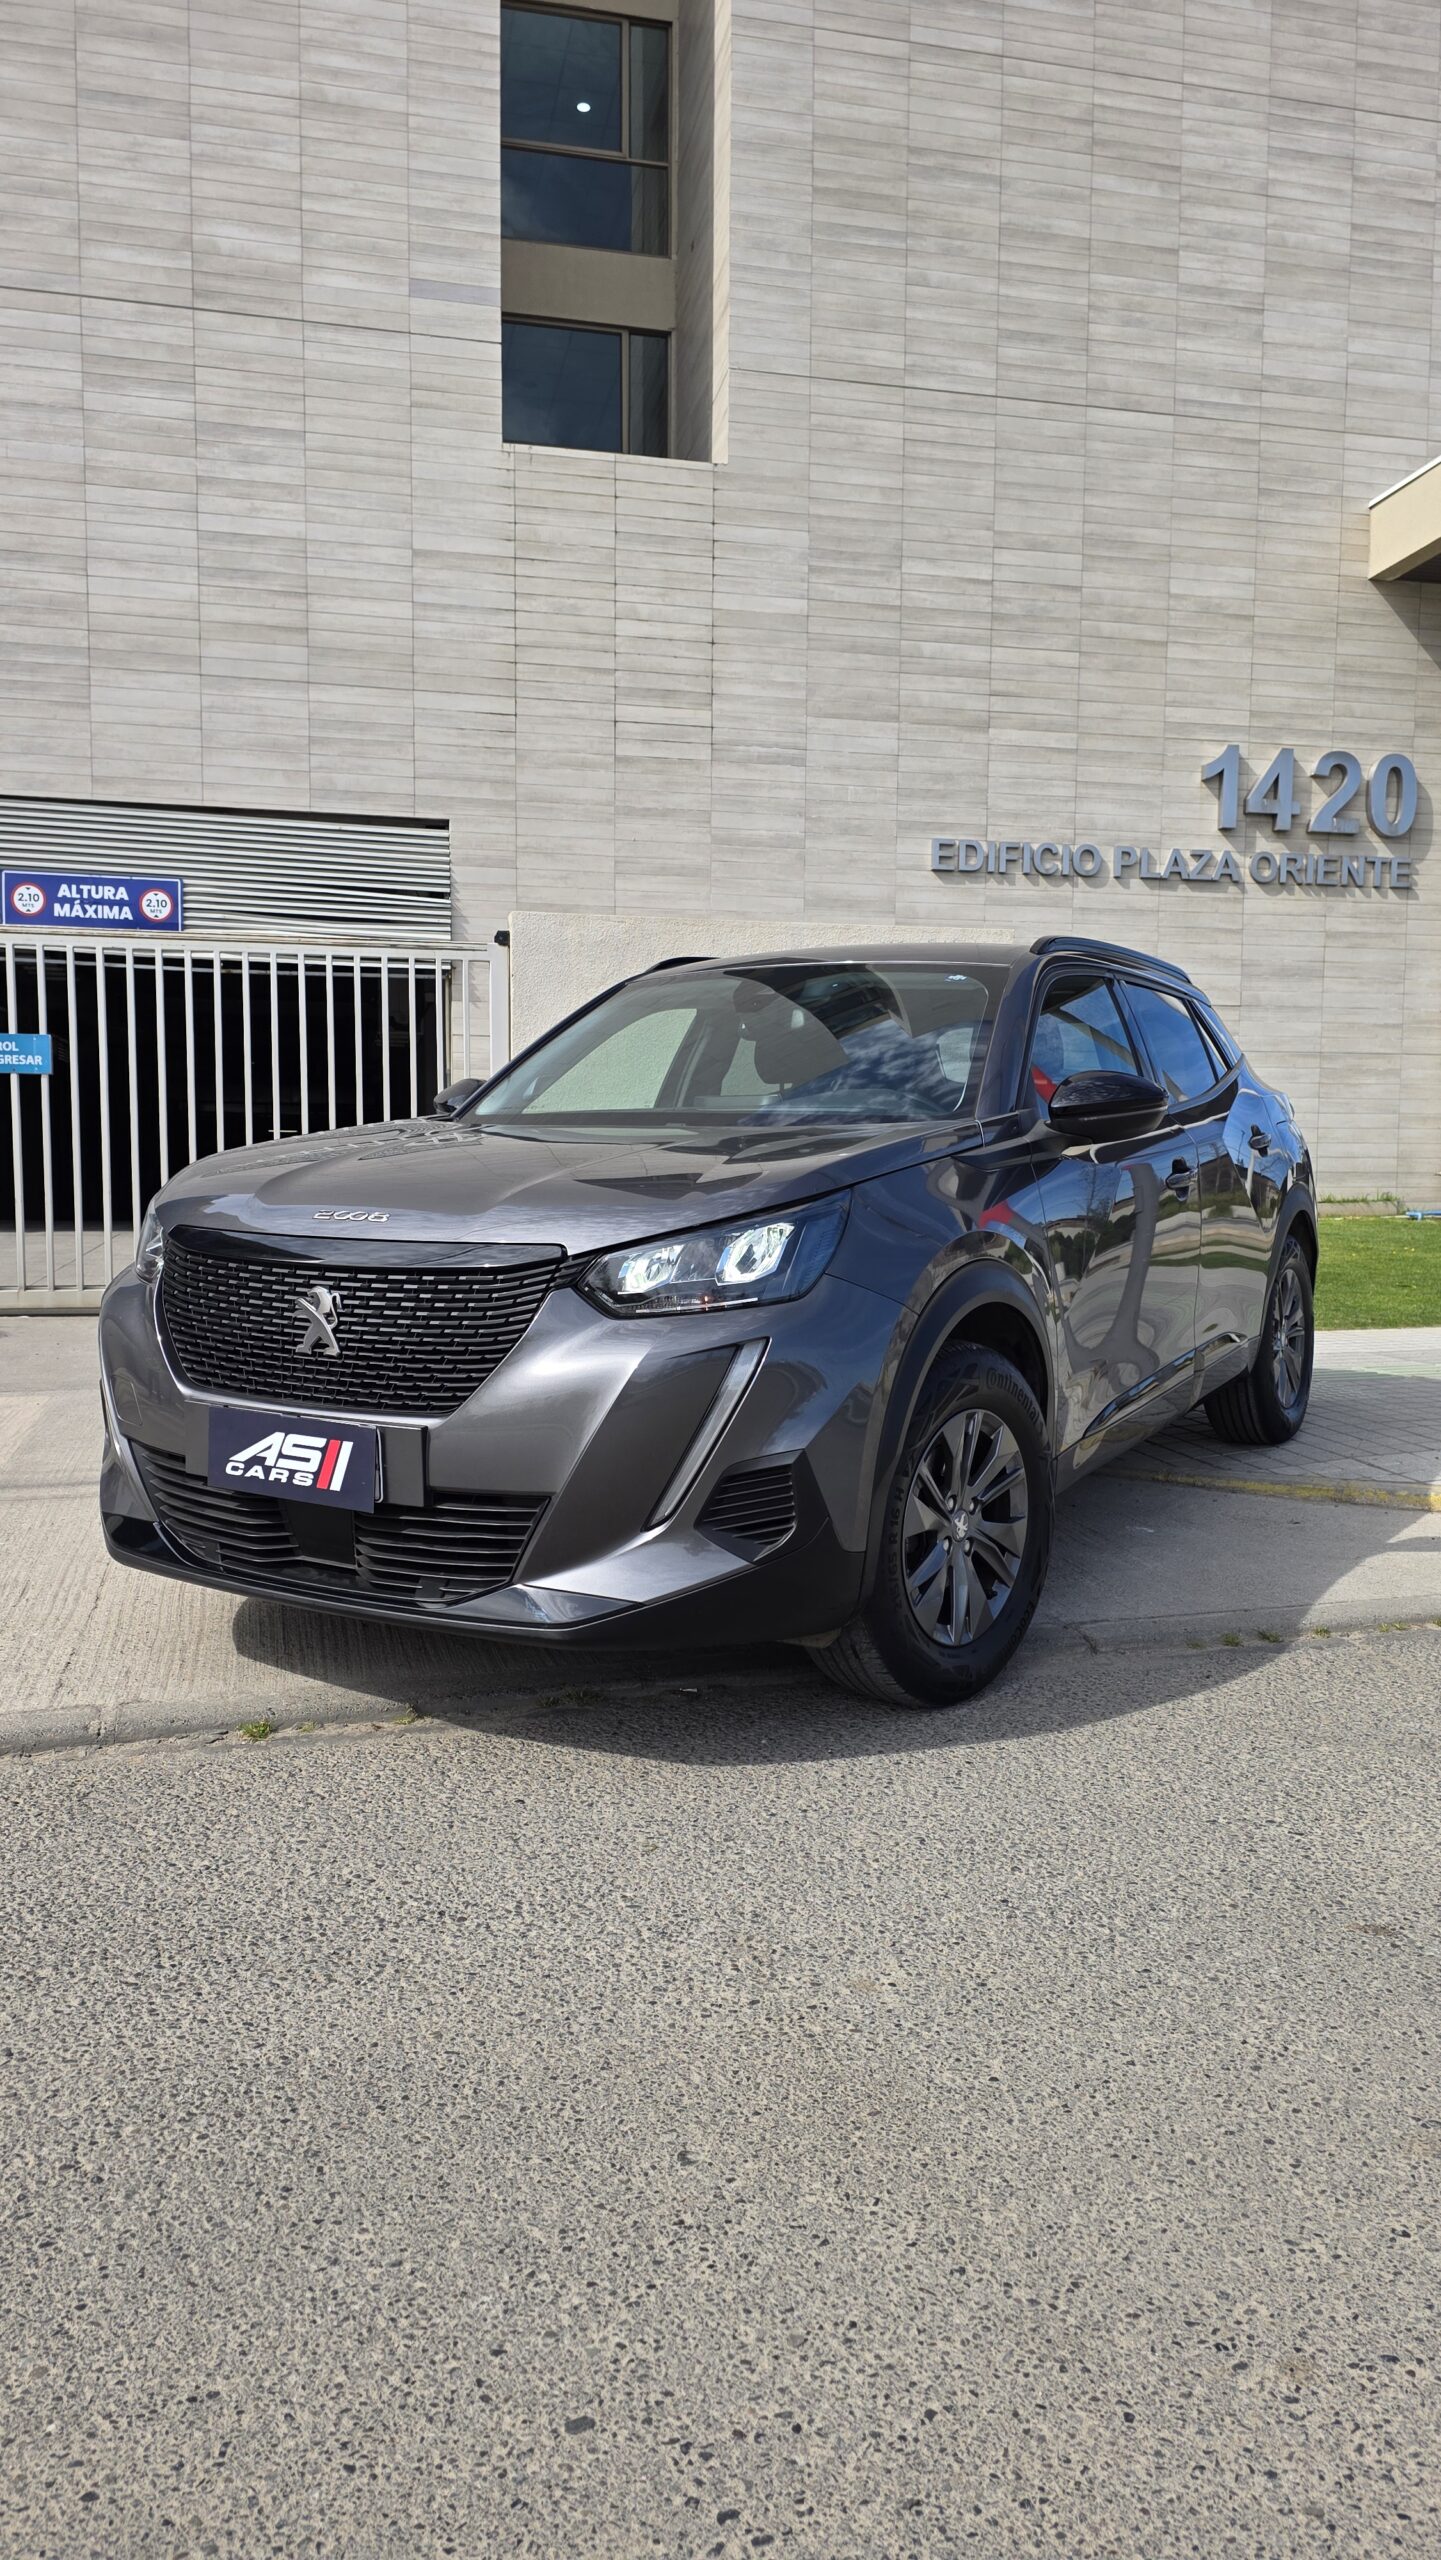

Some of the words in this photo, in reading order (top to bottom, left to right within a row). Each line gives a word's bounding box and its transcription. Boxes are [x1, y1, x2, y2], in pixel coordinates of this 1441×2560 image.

[1201, 744, 1418, 838] 1420
[930, 838, 1101, 877] EDIFICIO
[1113, 846, 1240, 883] PLAZA
[1250, 851, 1413, 889] ORIENTE
[17, 893, 40, 902] 2.10
[57, 884, 129, 900] ALTURA
[53, 900, 133, 920] MÁXIMA
[146, 899, 168, 909] 2.10
[312, 1209, 390, 1222] 2008
[986, 1368, 1040, 1425] Continental
[225, 1461, 314, 1487] CARS
[896, 1488, 905, 1501] H
[891, 1508, 900, 1526] 16
[890, 1533, 898, 1544] R
